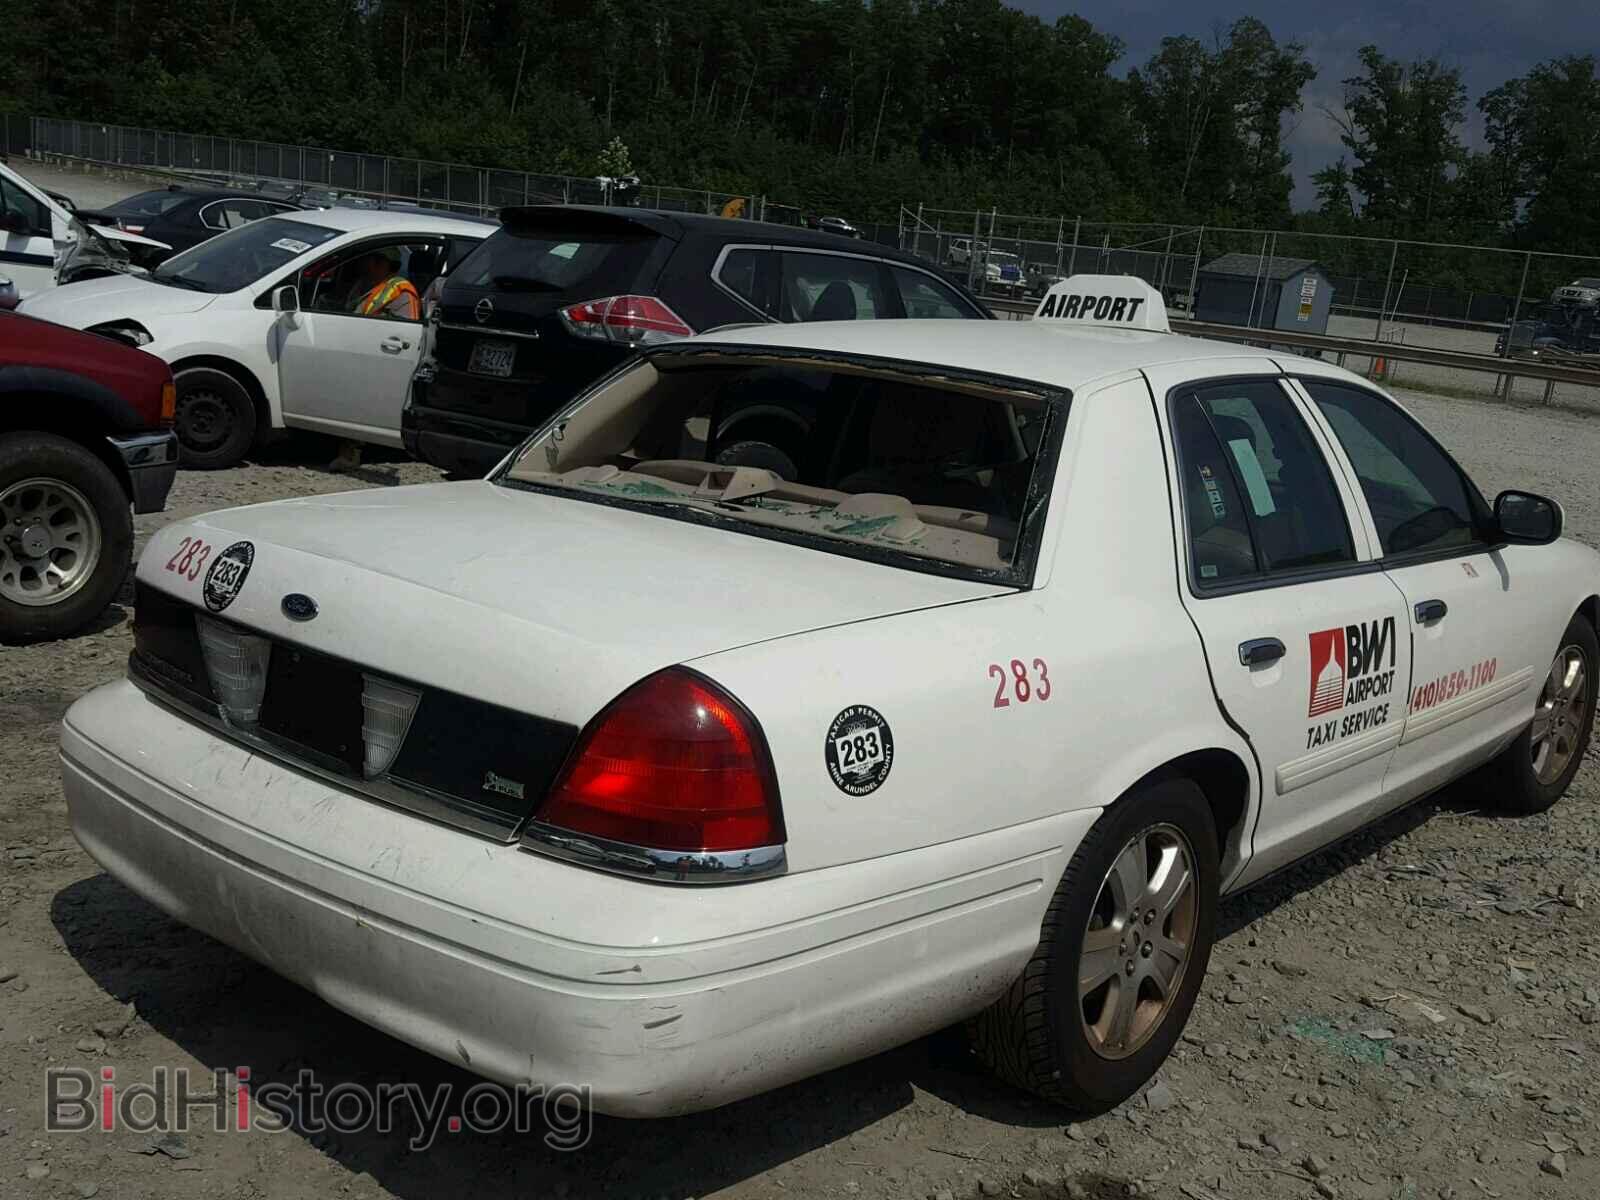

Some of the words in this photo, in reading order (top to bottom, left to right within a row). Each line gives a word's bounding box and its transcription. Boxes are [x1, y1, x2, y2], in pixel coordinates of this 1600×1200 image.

[1039, 294, 1145, 322] AIRPORT
[165, 537, 211, 582] 283
[213, 560, 241, 586] 283
[1345, 616, 1396, 680] BWI
[988, 658, 1051, 708] 283
[1345, 670, 1395, 707] AIRPORT
[1408, 657, 1497, 715] (410)859-1100
[828, 707, 855, 743] TAXICAB
[858, 707, 886, 728] PERMIT
[1306, 720, 1338, 750] TAXI
[1340, 702, 1390, 738] SERVICE
[829, 762, 844, 785] ANNE
[844, 781, 879, 794] ARUNDEL
[878, 743, 893, 782] COUNTY
[840, 731, 879, 768] 283
